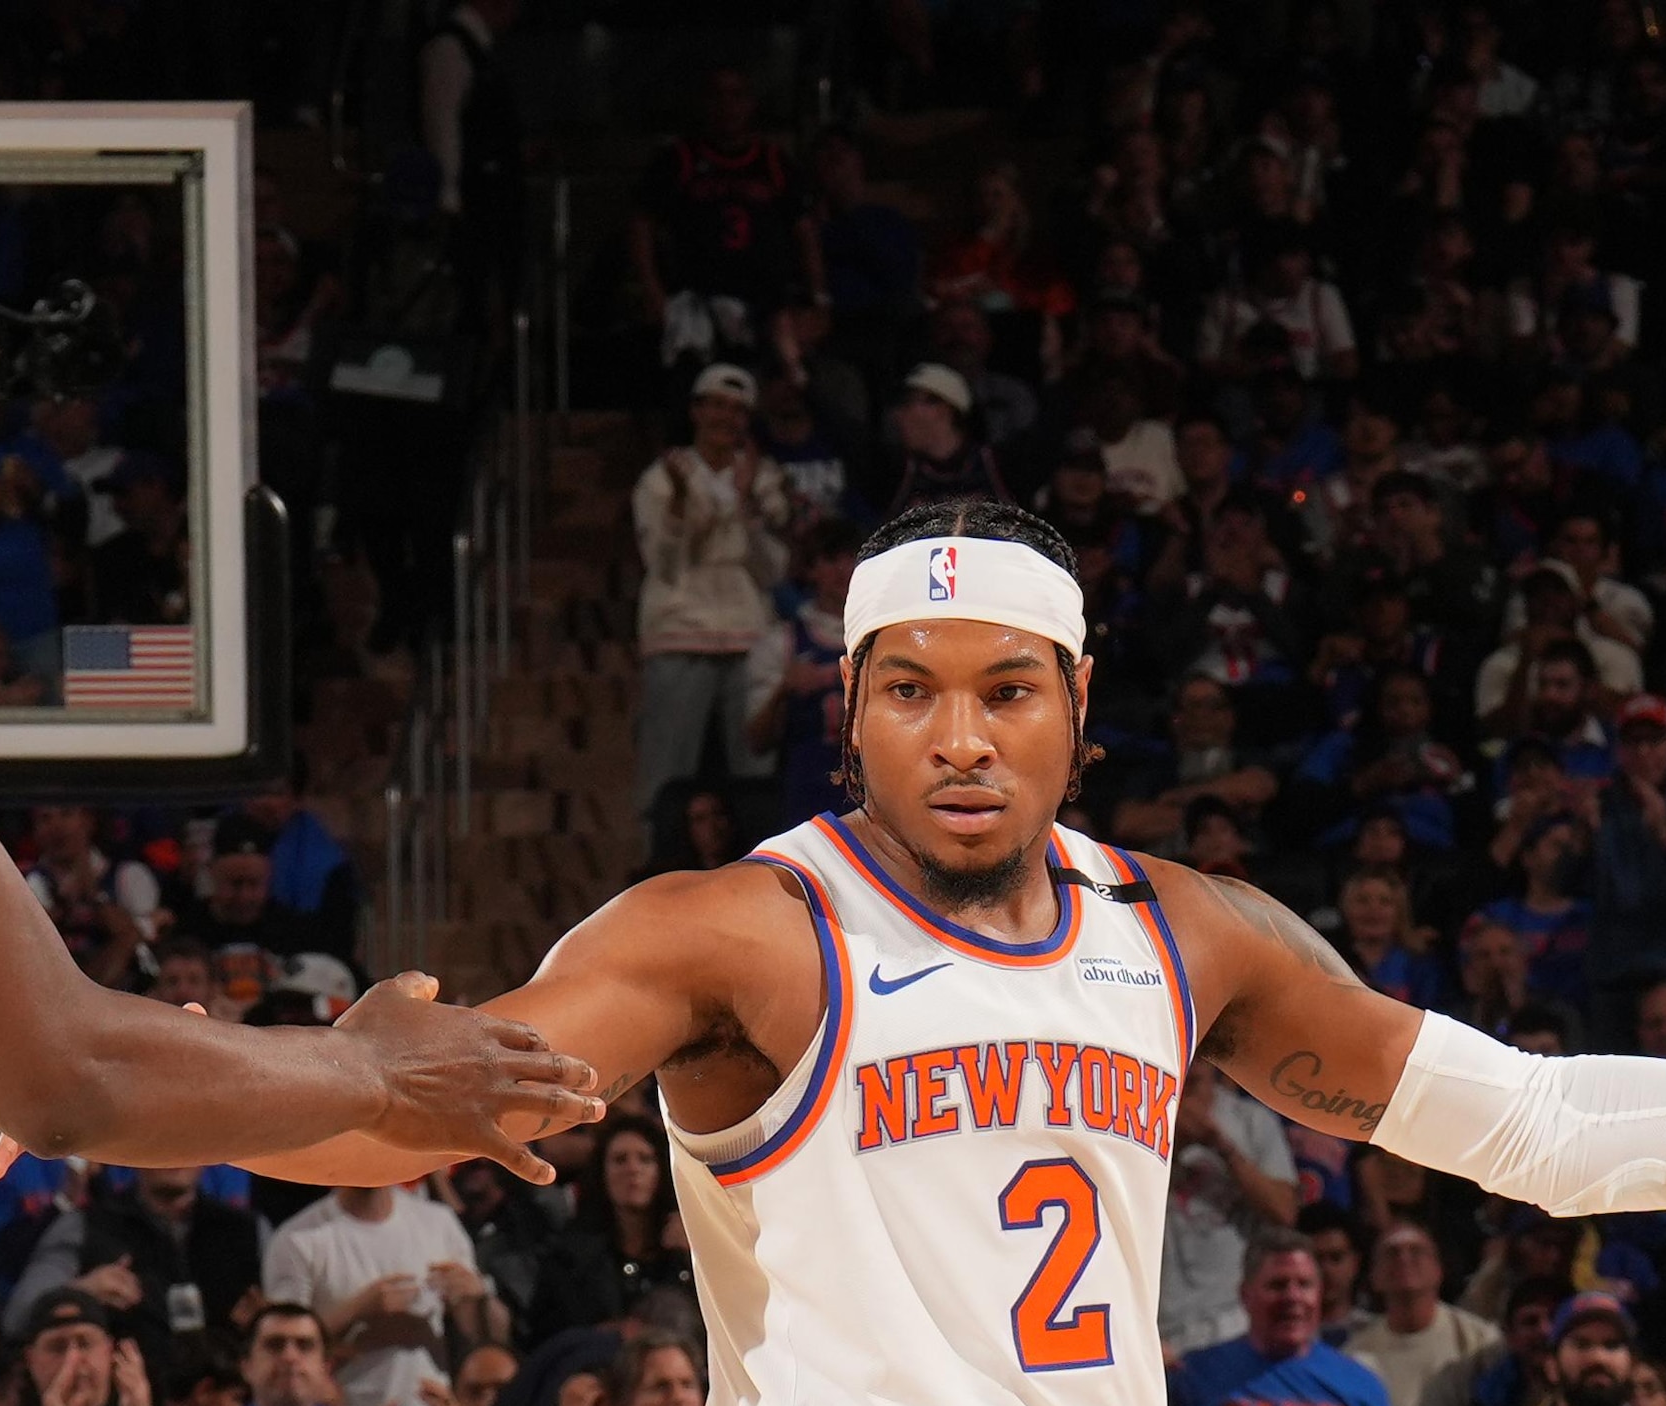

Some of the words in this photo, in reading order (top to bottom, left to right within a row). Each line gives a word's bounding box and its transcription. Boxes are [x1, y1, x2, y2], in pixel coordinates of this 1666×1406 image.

[1084, 966, 1114, 983] abu
[1116, 968, 1163, 986] dhabi
[855, 1040, 1030, 1154] NEW
[1033, 1039, 1180, 1166] YORK
[1270, 1050, 1386, 1132] Going
[998, 1157, 1115, 1373] 2
